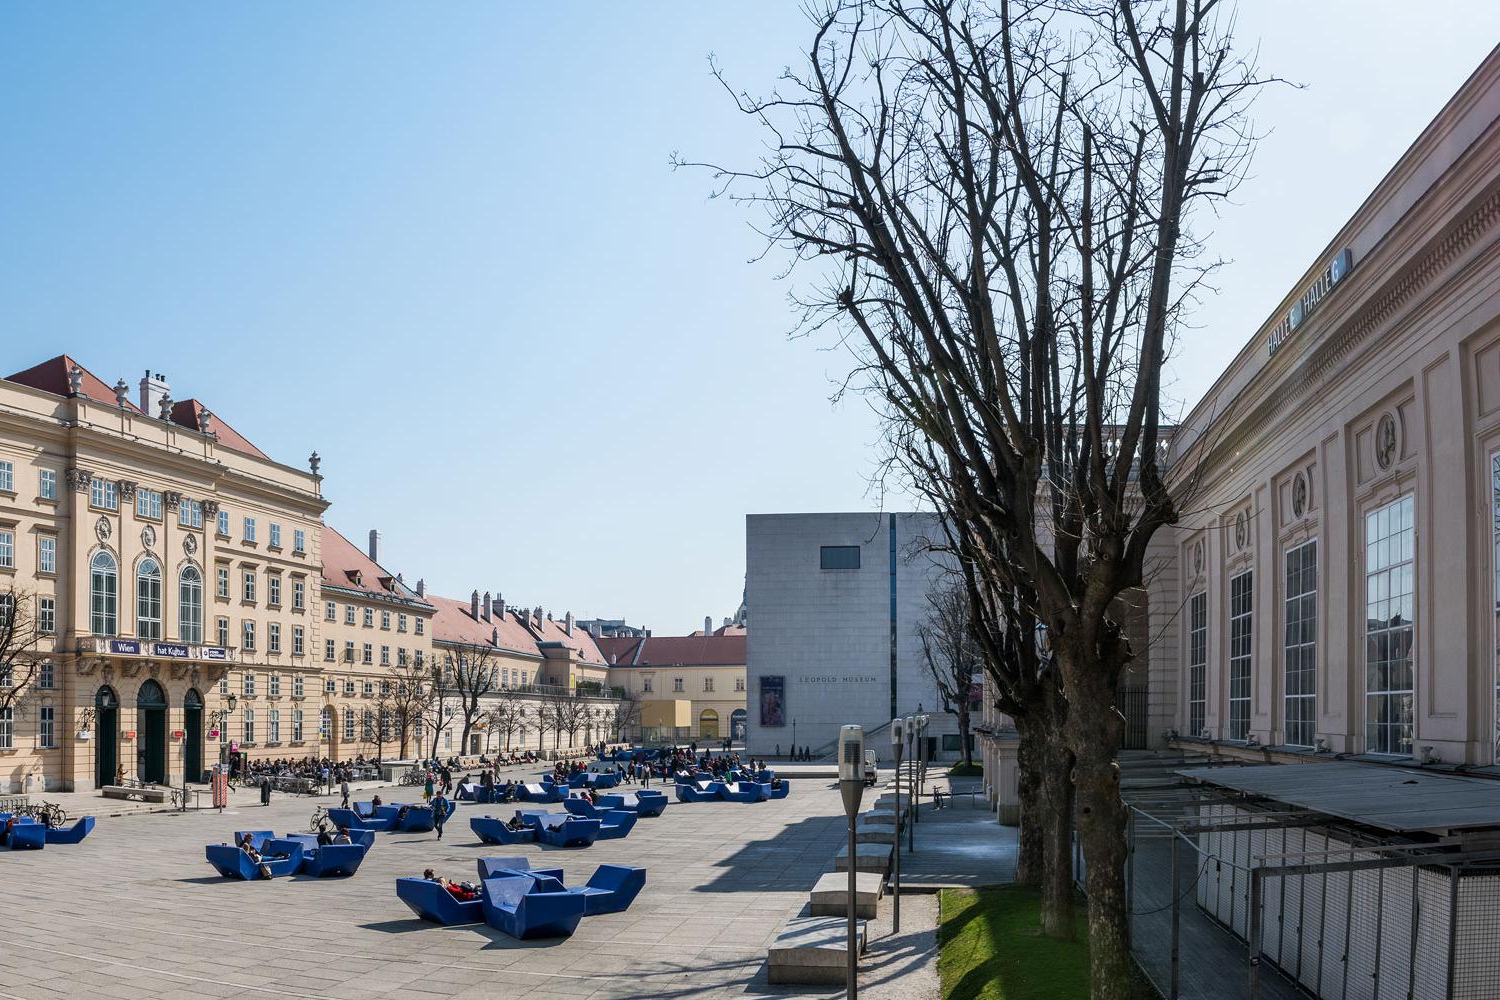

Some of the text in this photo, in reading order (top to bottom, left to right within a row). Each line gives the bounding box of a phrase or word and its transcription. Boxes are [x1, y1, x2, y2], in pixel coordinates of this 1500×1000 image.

[1267, 314, 1290, 357] HALLE
[1303, 268, 1331, 316] HALLE
[1331, 260, 1339, 282] G
[117, 643, 135, 653] Wien
[157, 645, 168, 655] hat
